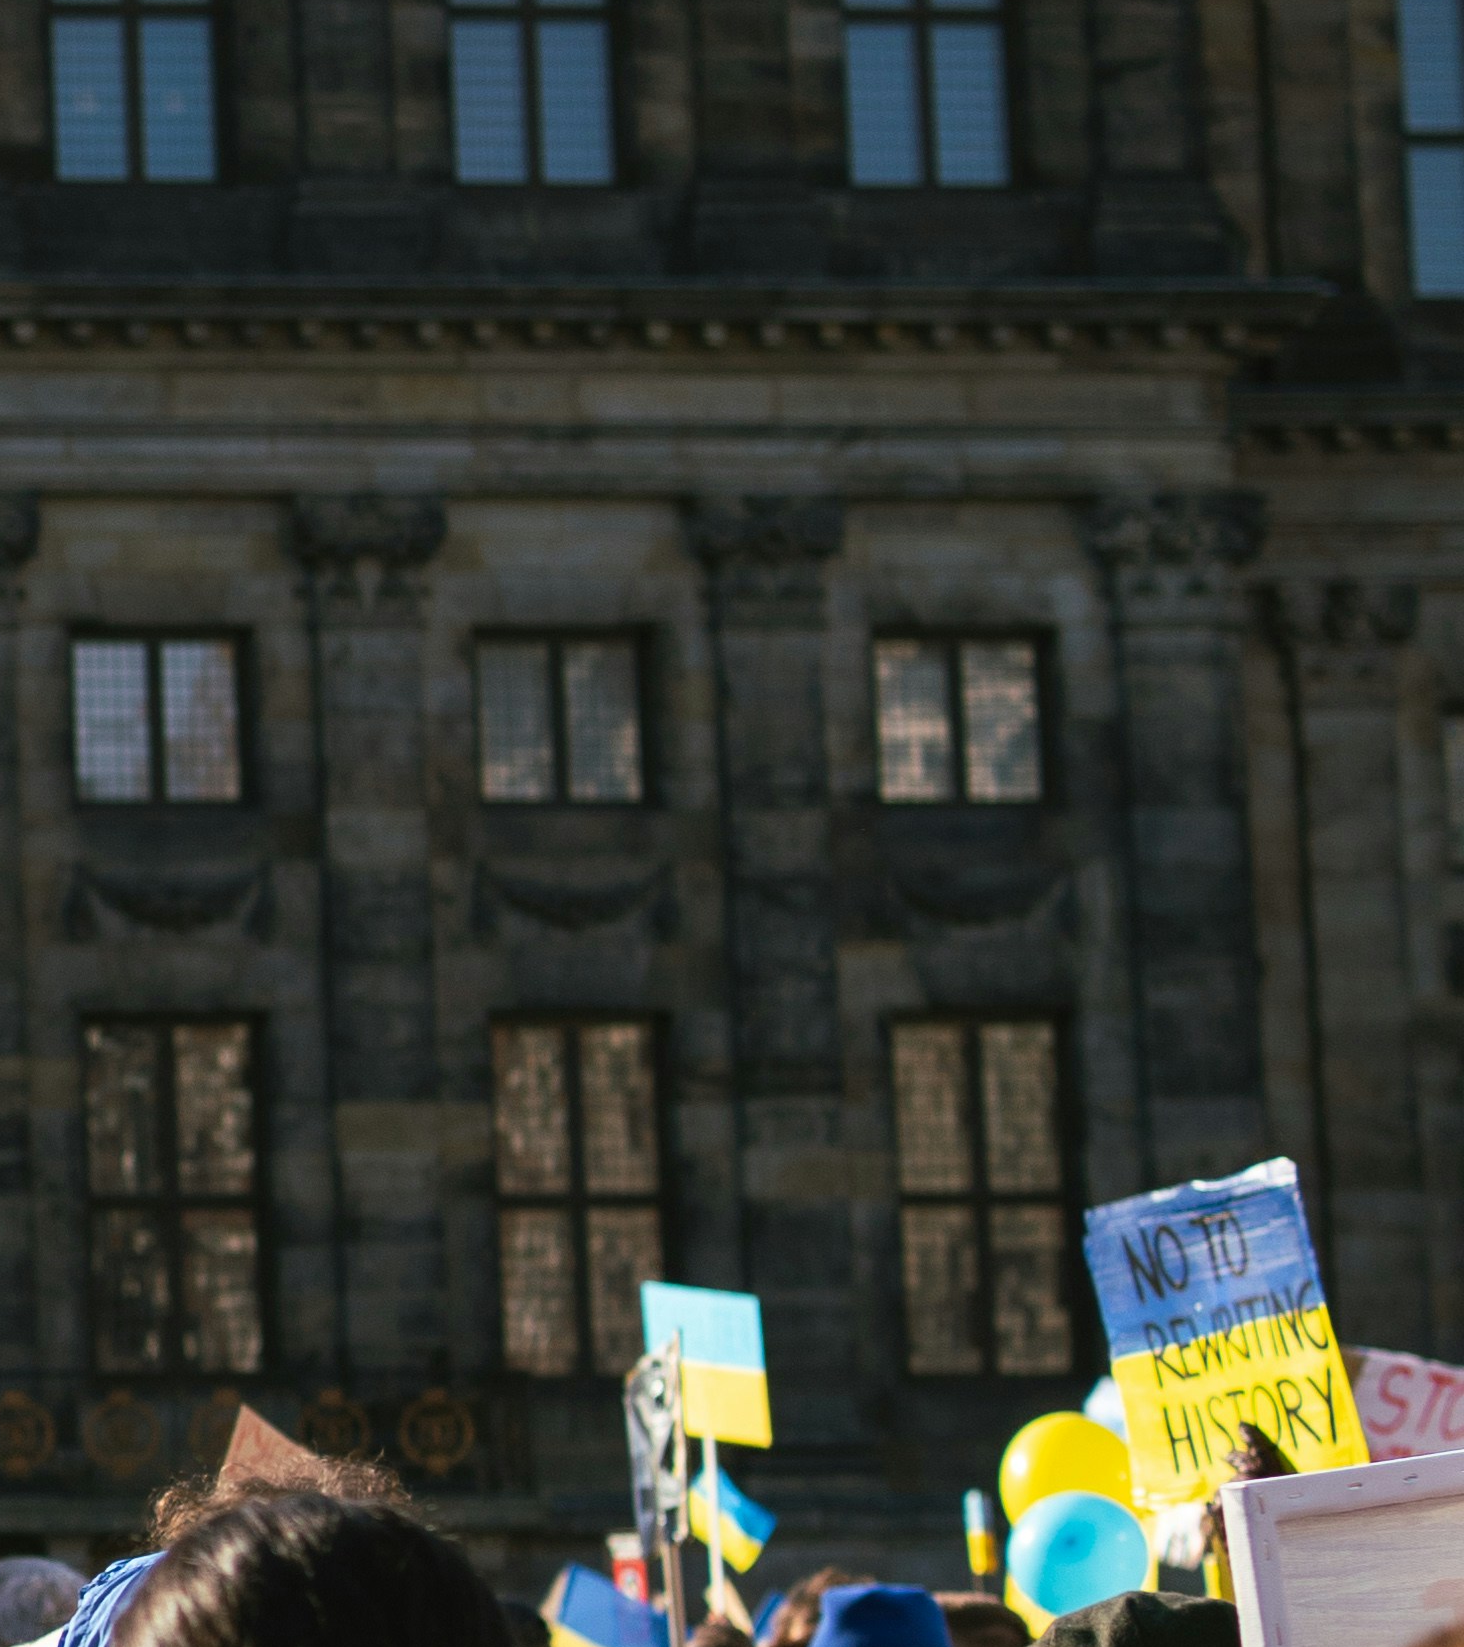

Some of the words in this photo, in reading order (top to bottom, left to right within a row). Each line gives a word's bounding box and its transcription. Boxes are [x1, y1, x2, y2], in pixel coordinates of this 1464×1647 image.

[1121, 1225, 1189, 1305] NO
[1190, 1211, 1248, 1283] TO
[1144, 1279, 1329, 1389] REWRITING
